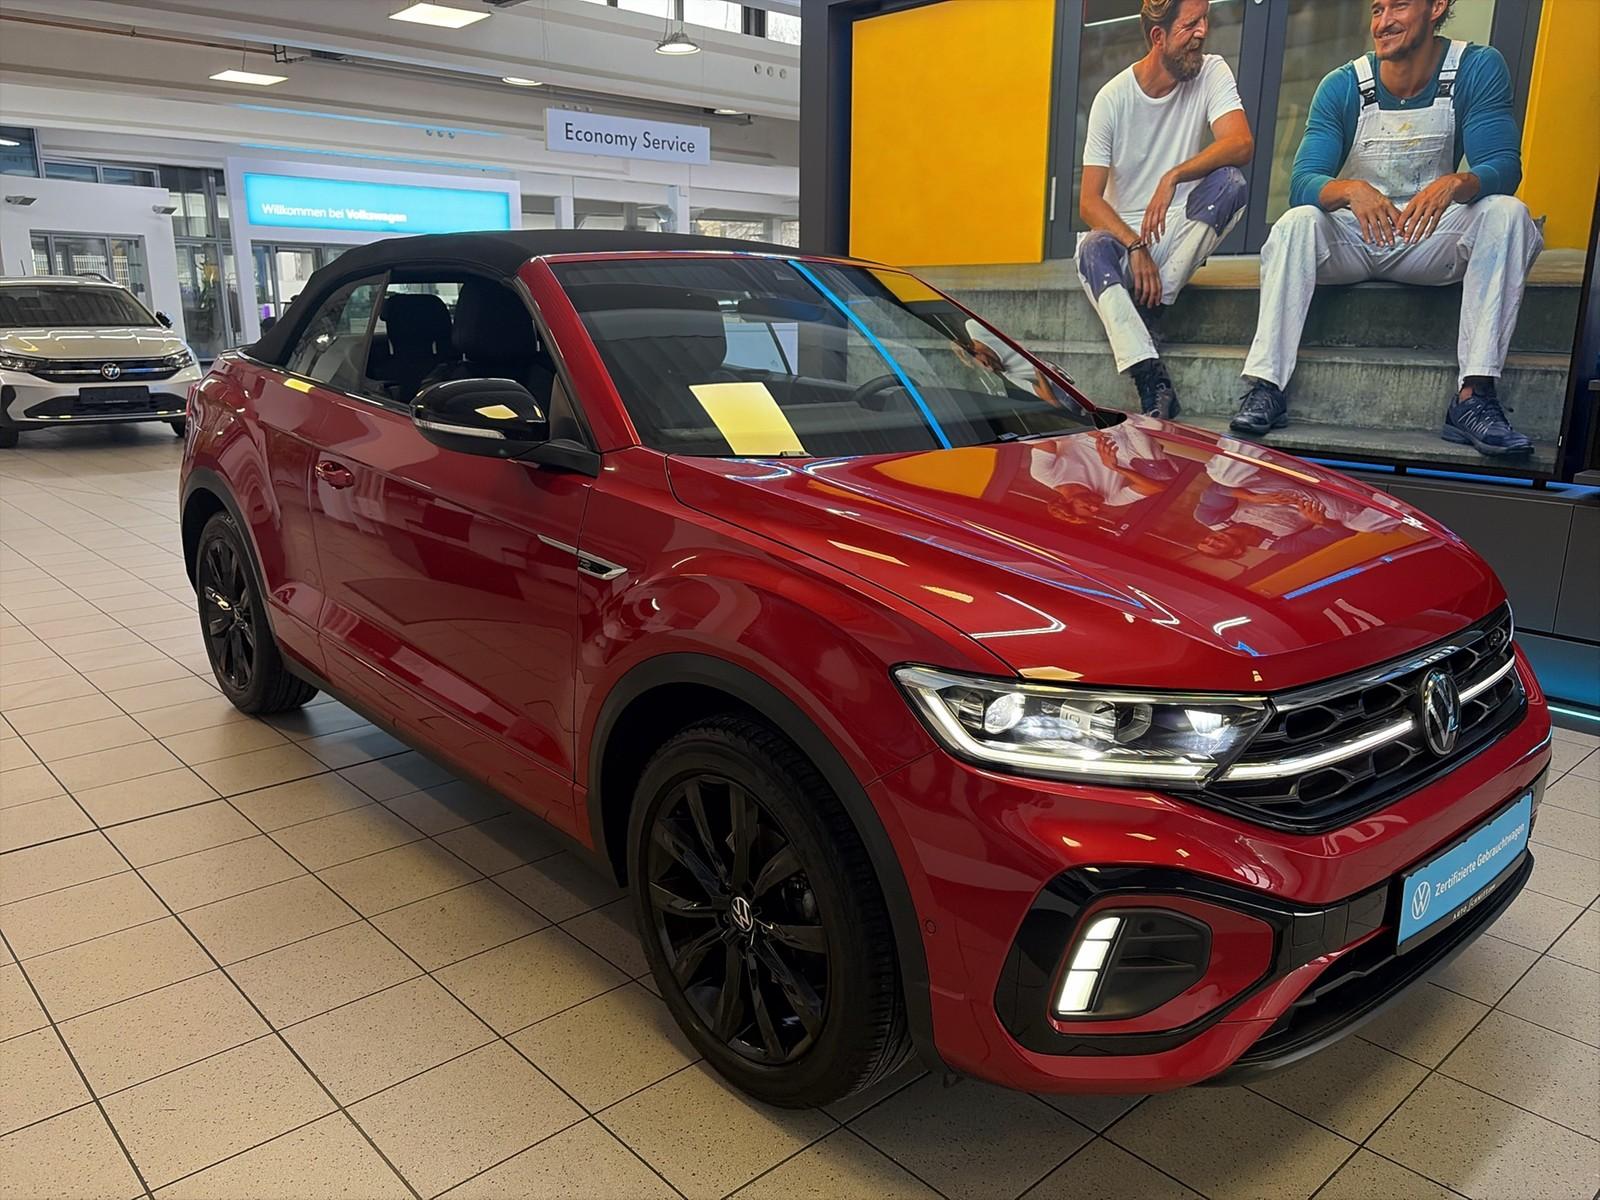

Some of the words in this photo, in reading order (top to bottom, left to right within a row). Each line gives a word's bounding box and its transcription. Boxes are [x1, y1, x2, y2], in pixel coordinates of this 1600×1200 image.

[565, 122, 638, 151] Economy
[643, 131, 696, 153] Service
[261, 203, 327, 218] Willkommen
[328, 207, 344, 219] bei
[345, 208, 408, 224] Volkswagen
[1434, 860, 1476, 897] Zertifizierte
[1476, 823, 1525, 868] Gebrauchtwagen
